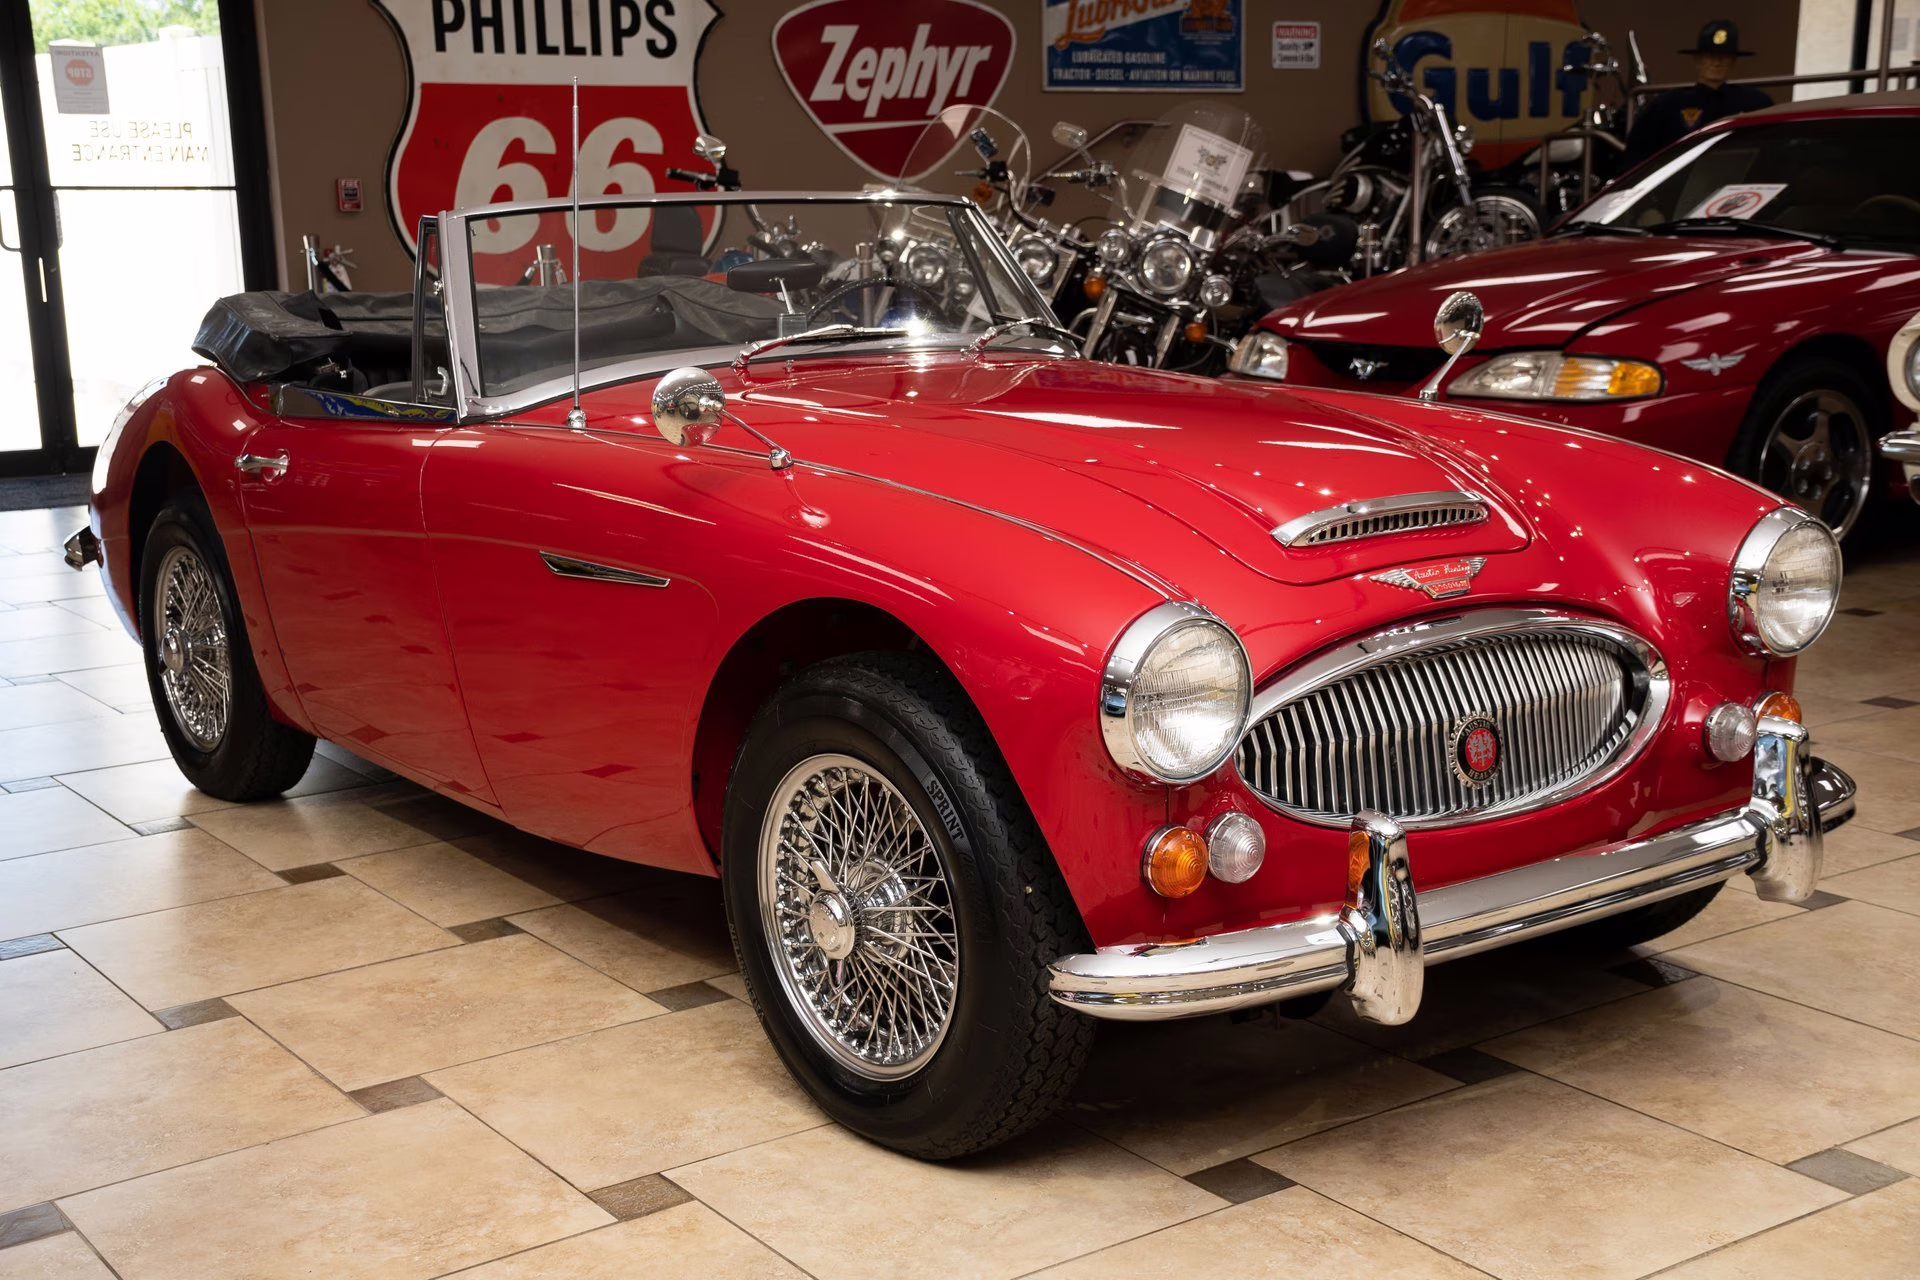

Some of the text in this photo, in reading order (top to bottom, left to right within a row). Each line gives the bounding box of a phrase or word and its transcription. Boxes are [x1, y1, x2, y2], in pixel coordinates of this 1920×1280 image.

[432, 0, 677, 58] PHILLIPS
[1072, 51, 1165, 64] LUBRICATED GASOLINE
[810, 23, 993, 118] Zephyr
[1387, 31, 1592, 124] Gulf
[454, 117, 664, 254] 66
[926, 780, 964, 841] SPRINT
